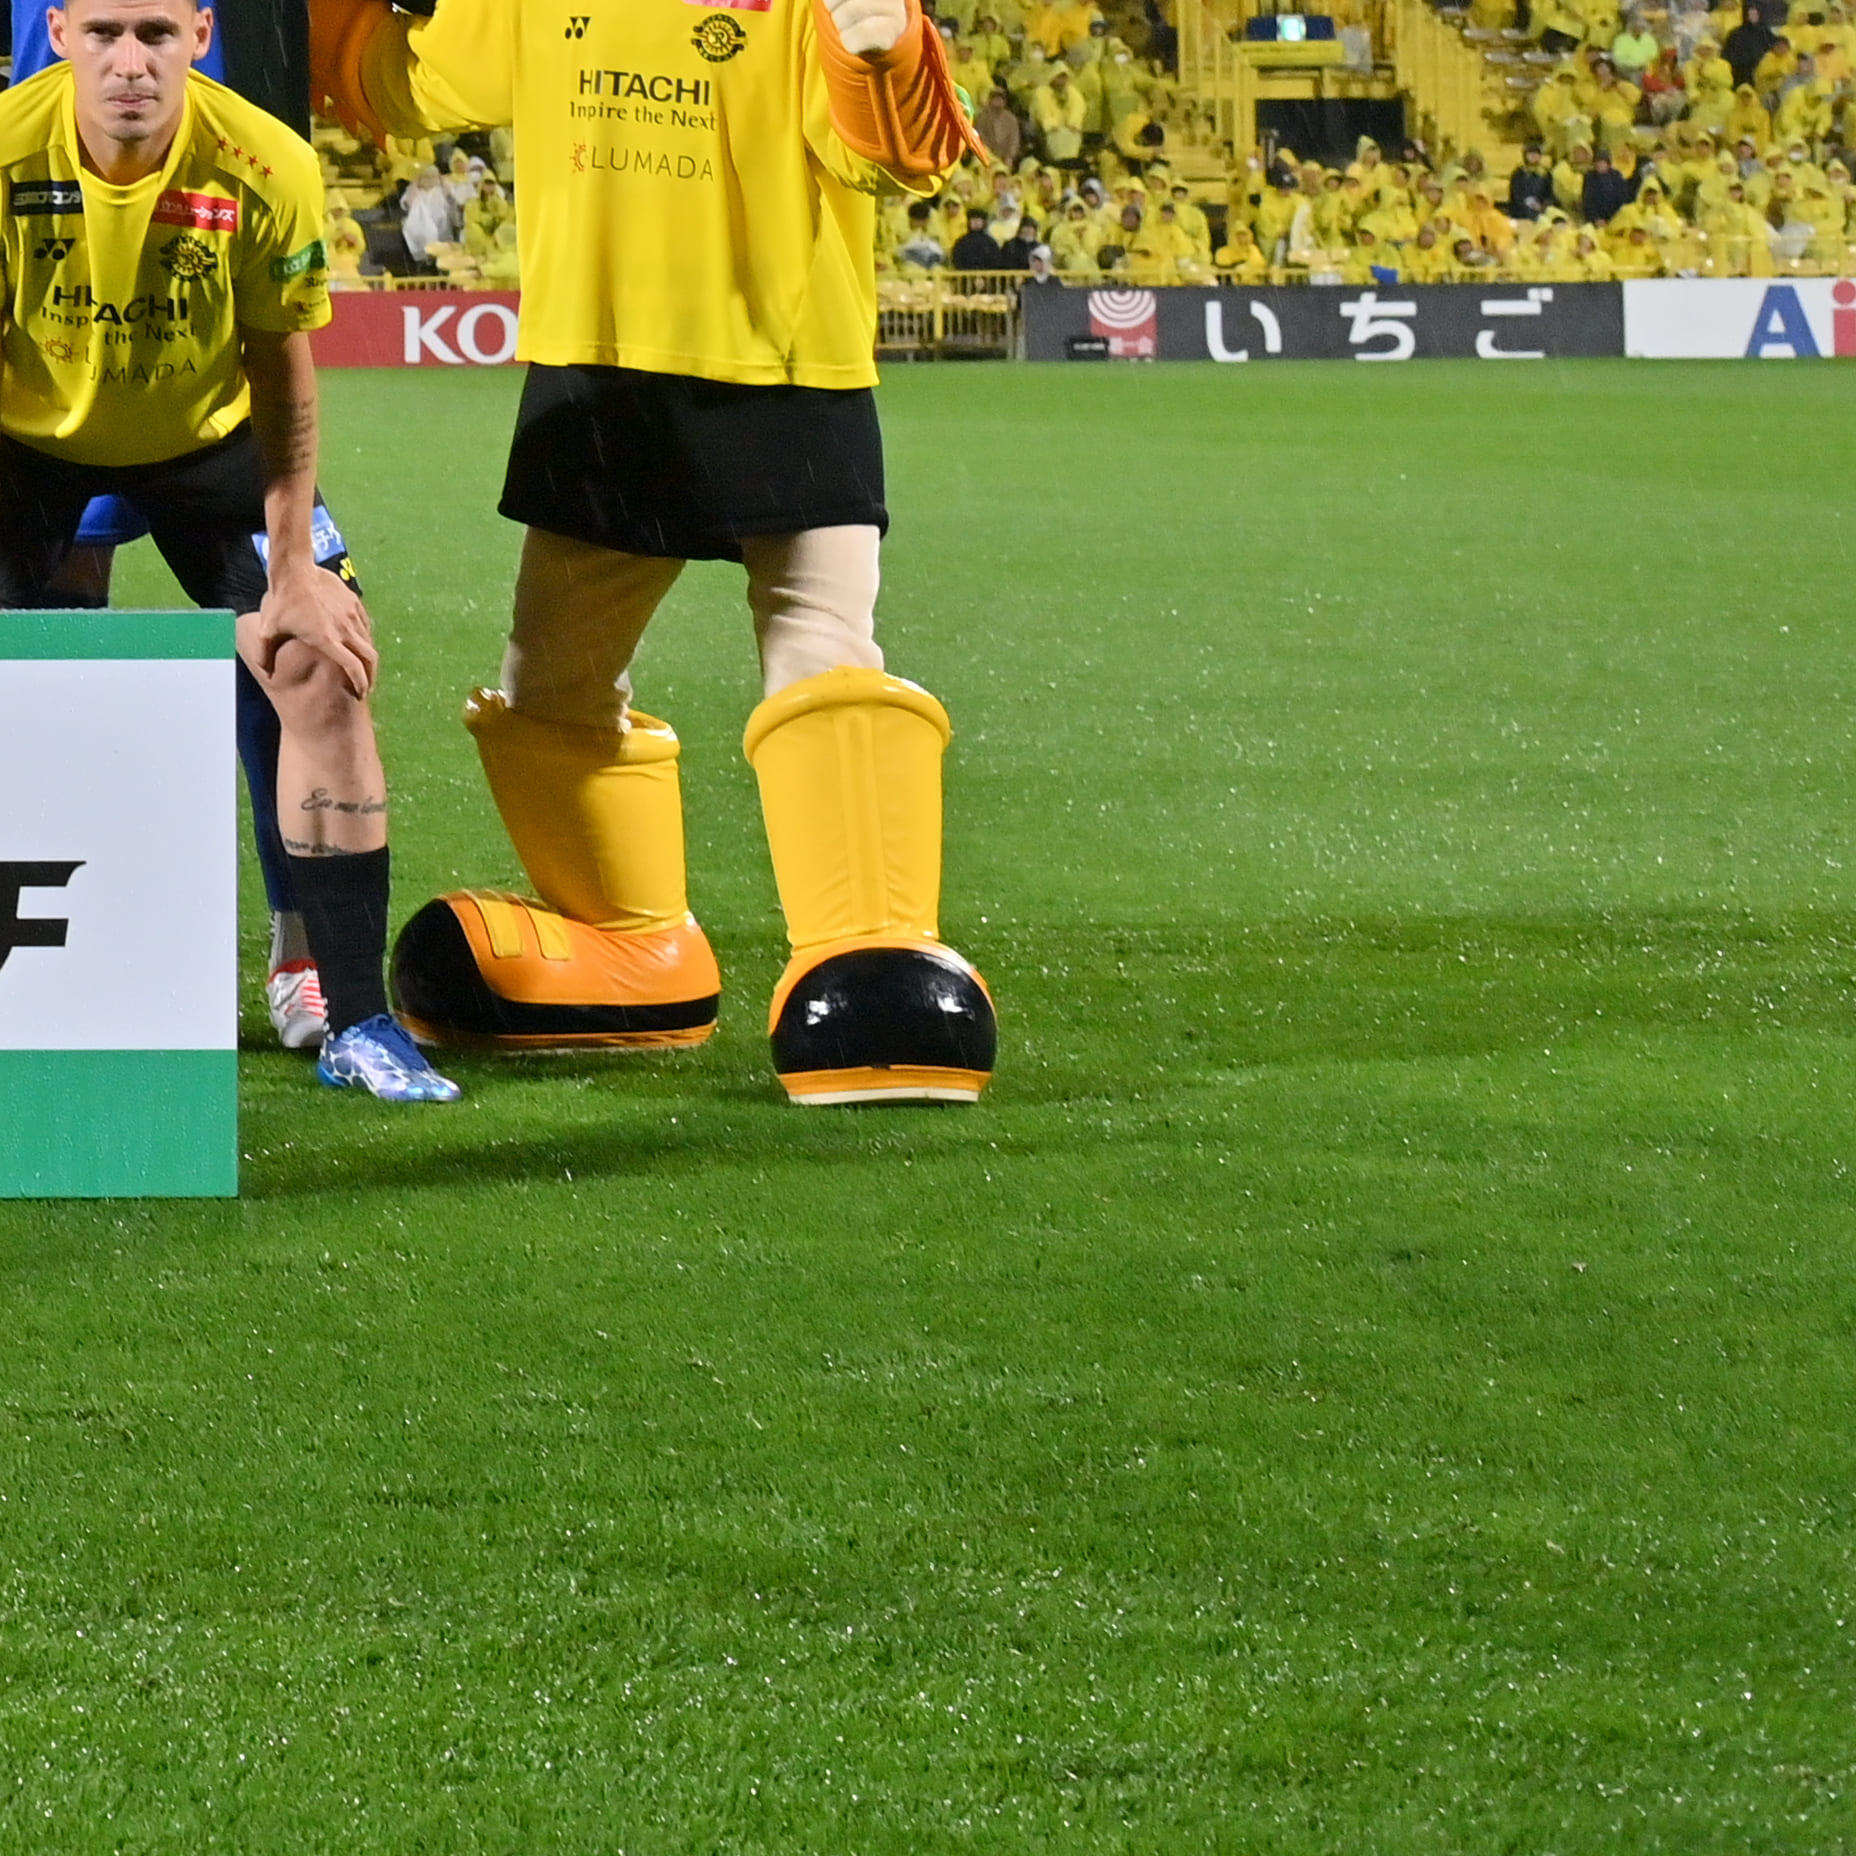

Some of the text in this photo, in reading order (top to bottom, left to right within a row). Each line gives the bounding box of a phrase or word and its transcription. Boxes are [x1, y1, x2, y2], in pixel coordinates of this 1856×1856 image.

[579, 69, 710, 106] HITACHI
[635, 105, 664, 125] the
[671, 109, 717, 132] Next
[591, 146, 714, 181] LUMADA
[145, 321, 198, 344] Next
[1204, 287, 1554, 363] いちご
